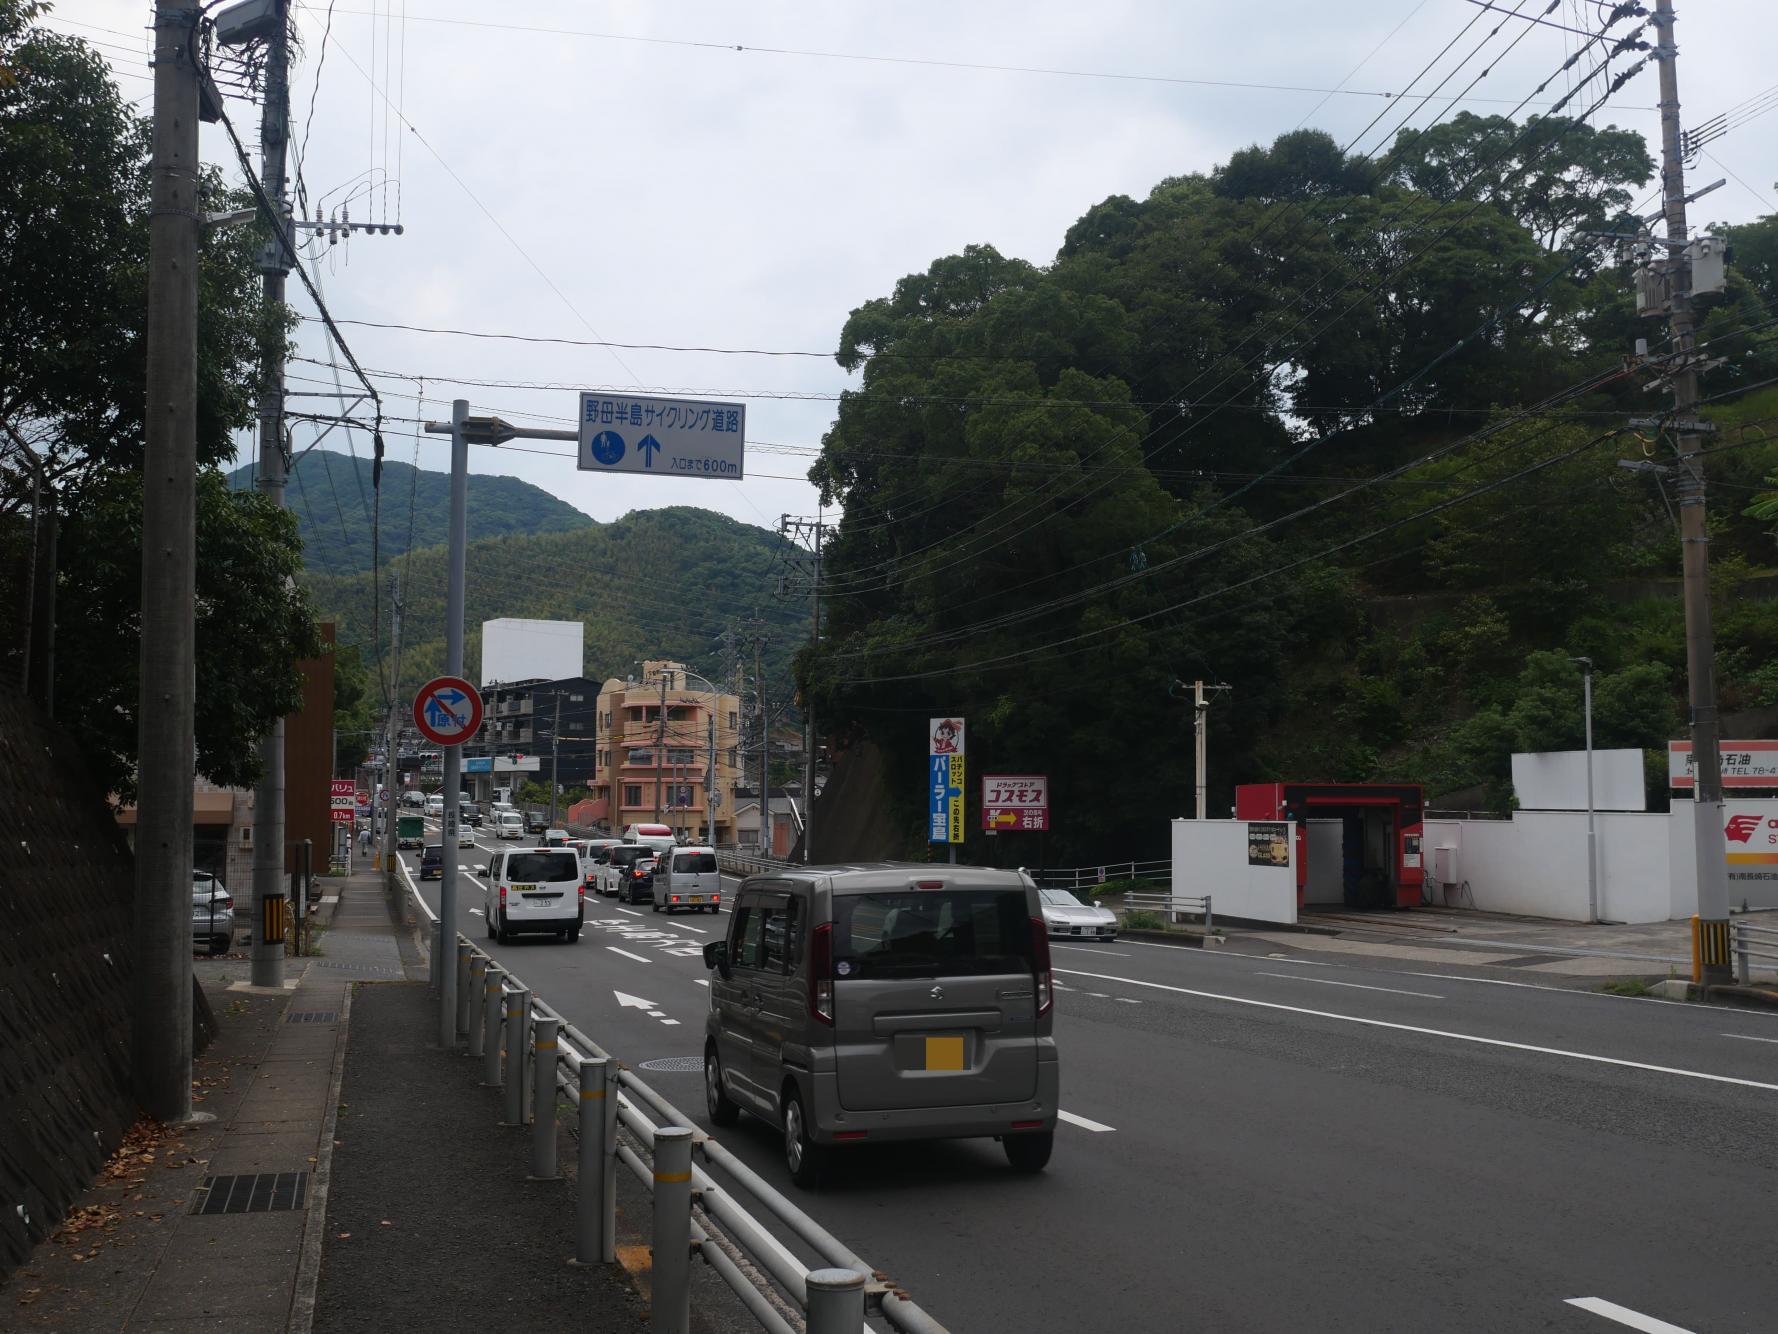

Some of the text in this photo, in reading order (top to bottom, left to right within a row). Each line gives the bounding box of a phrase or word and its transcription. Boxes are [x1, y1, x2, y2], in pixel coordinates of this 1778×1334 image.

[585, 399, 739, 433] 野母半島サイクリング道路
[670, 457, 737, 473] 入口まで600m
[437, 713, 466, 728] 原付
[996, 781, 1035, 789] ドラッグストア
[987, 789, 1043, 803] コスモス
[1022, 816, 1044, 829] 右折
